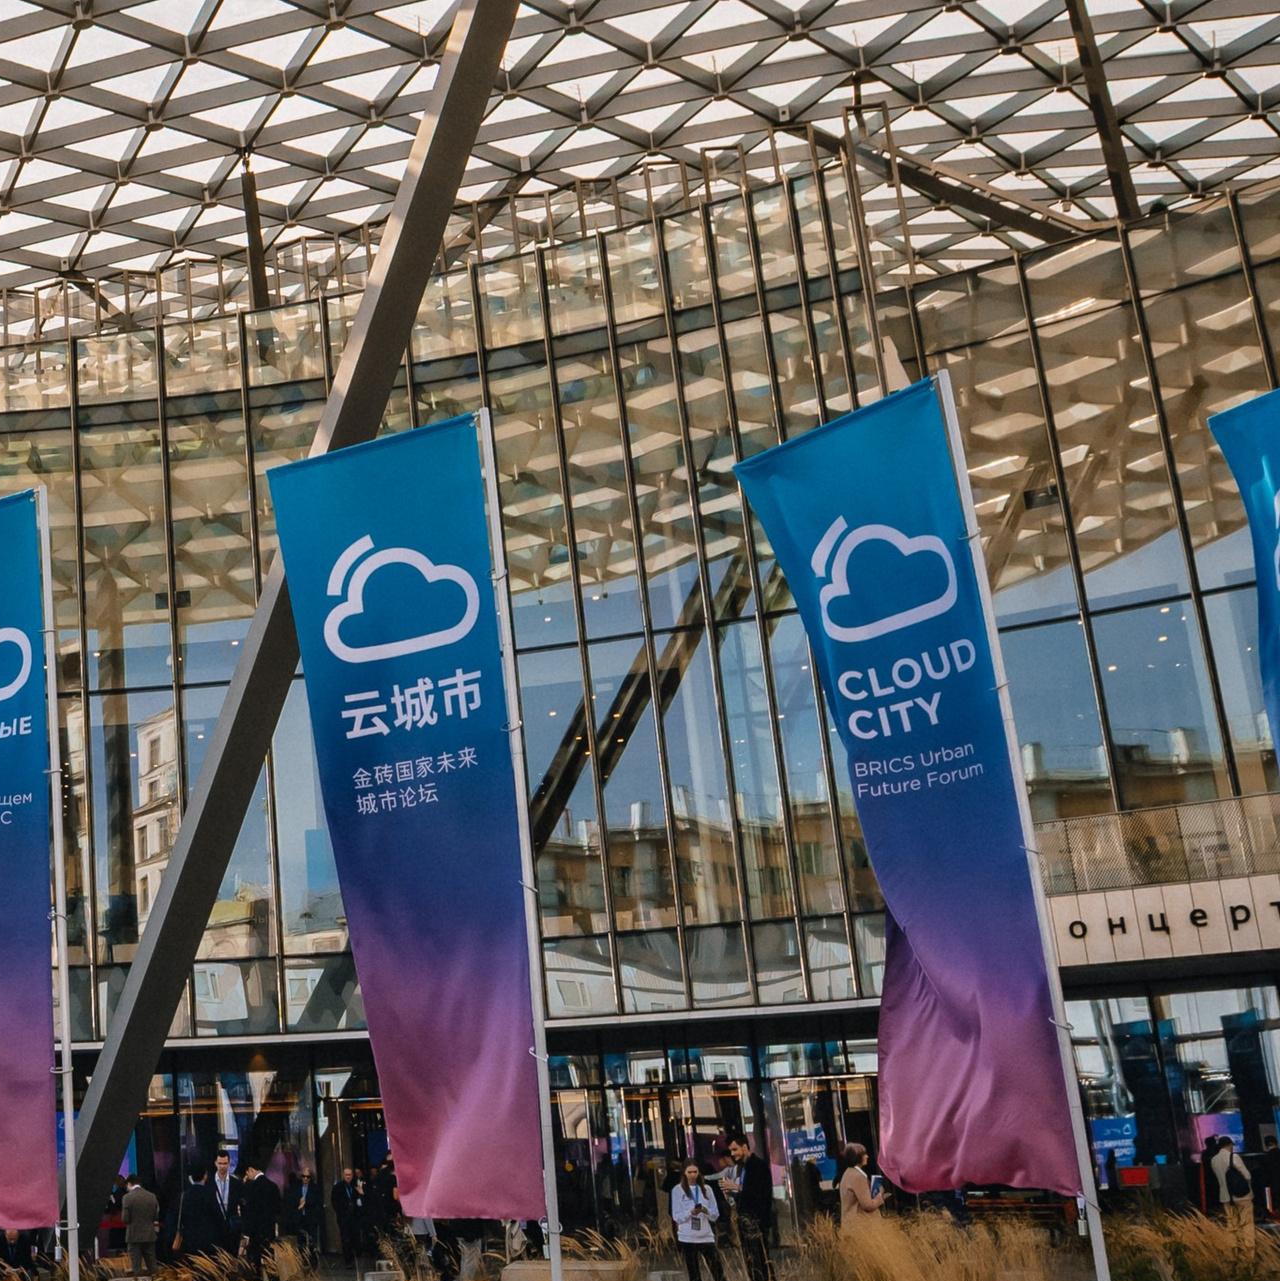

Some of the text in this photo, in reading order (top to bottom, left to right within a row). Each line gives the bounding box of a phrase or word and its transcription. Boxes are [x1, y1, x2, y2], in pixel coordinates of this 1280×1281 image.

[837, 638, 976, 701] CLOUD
[341, 668, 482, 740] 云城市
[848, 691, 942, 740] CITY
[352, 746, 479, 790] 金砖国家未来
[854, 743, 975, 778] BRICS Urban
[857, 763, 984, 799] Future Forum
[356, 782, 439, 815] 城市论坛
[1069, 901, 1280, 939] онцер
